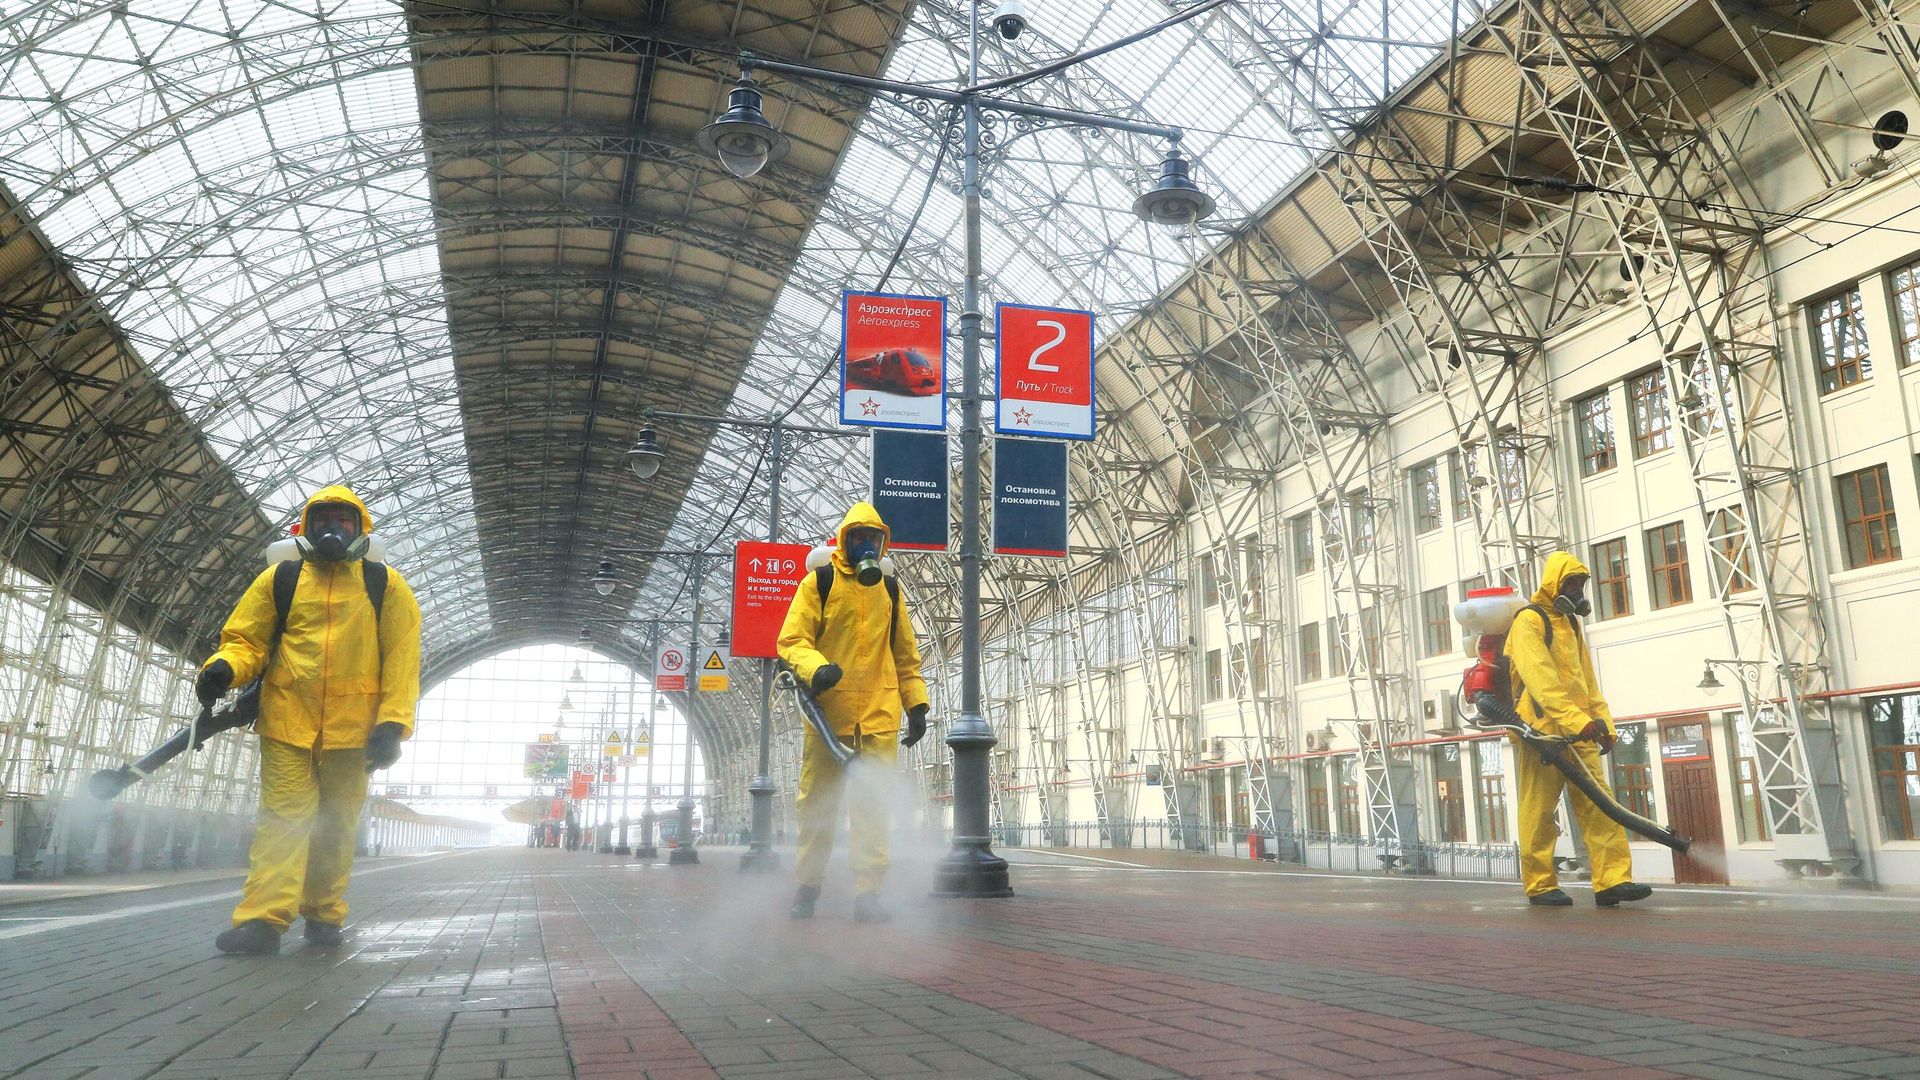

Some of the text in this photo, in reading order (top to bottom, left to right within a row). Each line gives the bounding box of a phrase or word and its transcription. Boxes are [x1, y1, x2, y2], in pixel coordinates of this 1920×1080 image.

[858, 302, 932, 317] Аэроэкспресс
[858, 314, 920, 329] Aeroexpress
[1027, 320, 1066, 373] 2
[1016, 380, 1040, 392] Путь
[1051, 383, 1074, 394] Track
[884, 477, 937, 488] Остановка
[879, 489, 941, 499] локомотива
[1005, 484, 1056, 495] Остановка
[1000, 496, 1060, 507] локомотива
[748, 576, 771, 584] Выход
